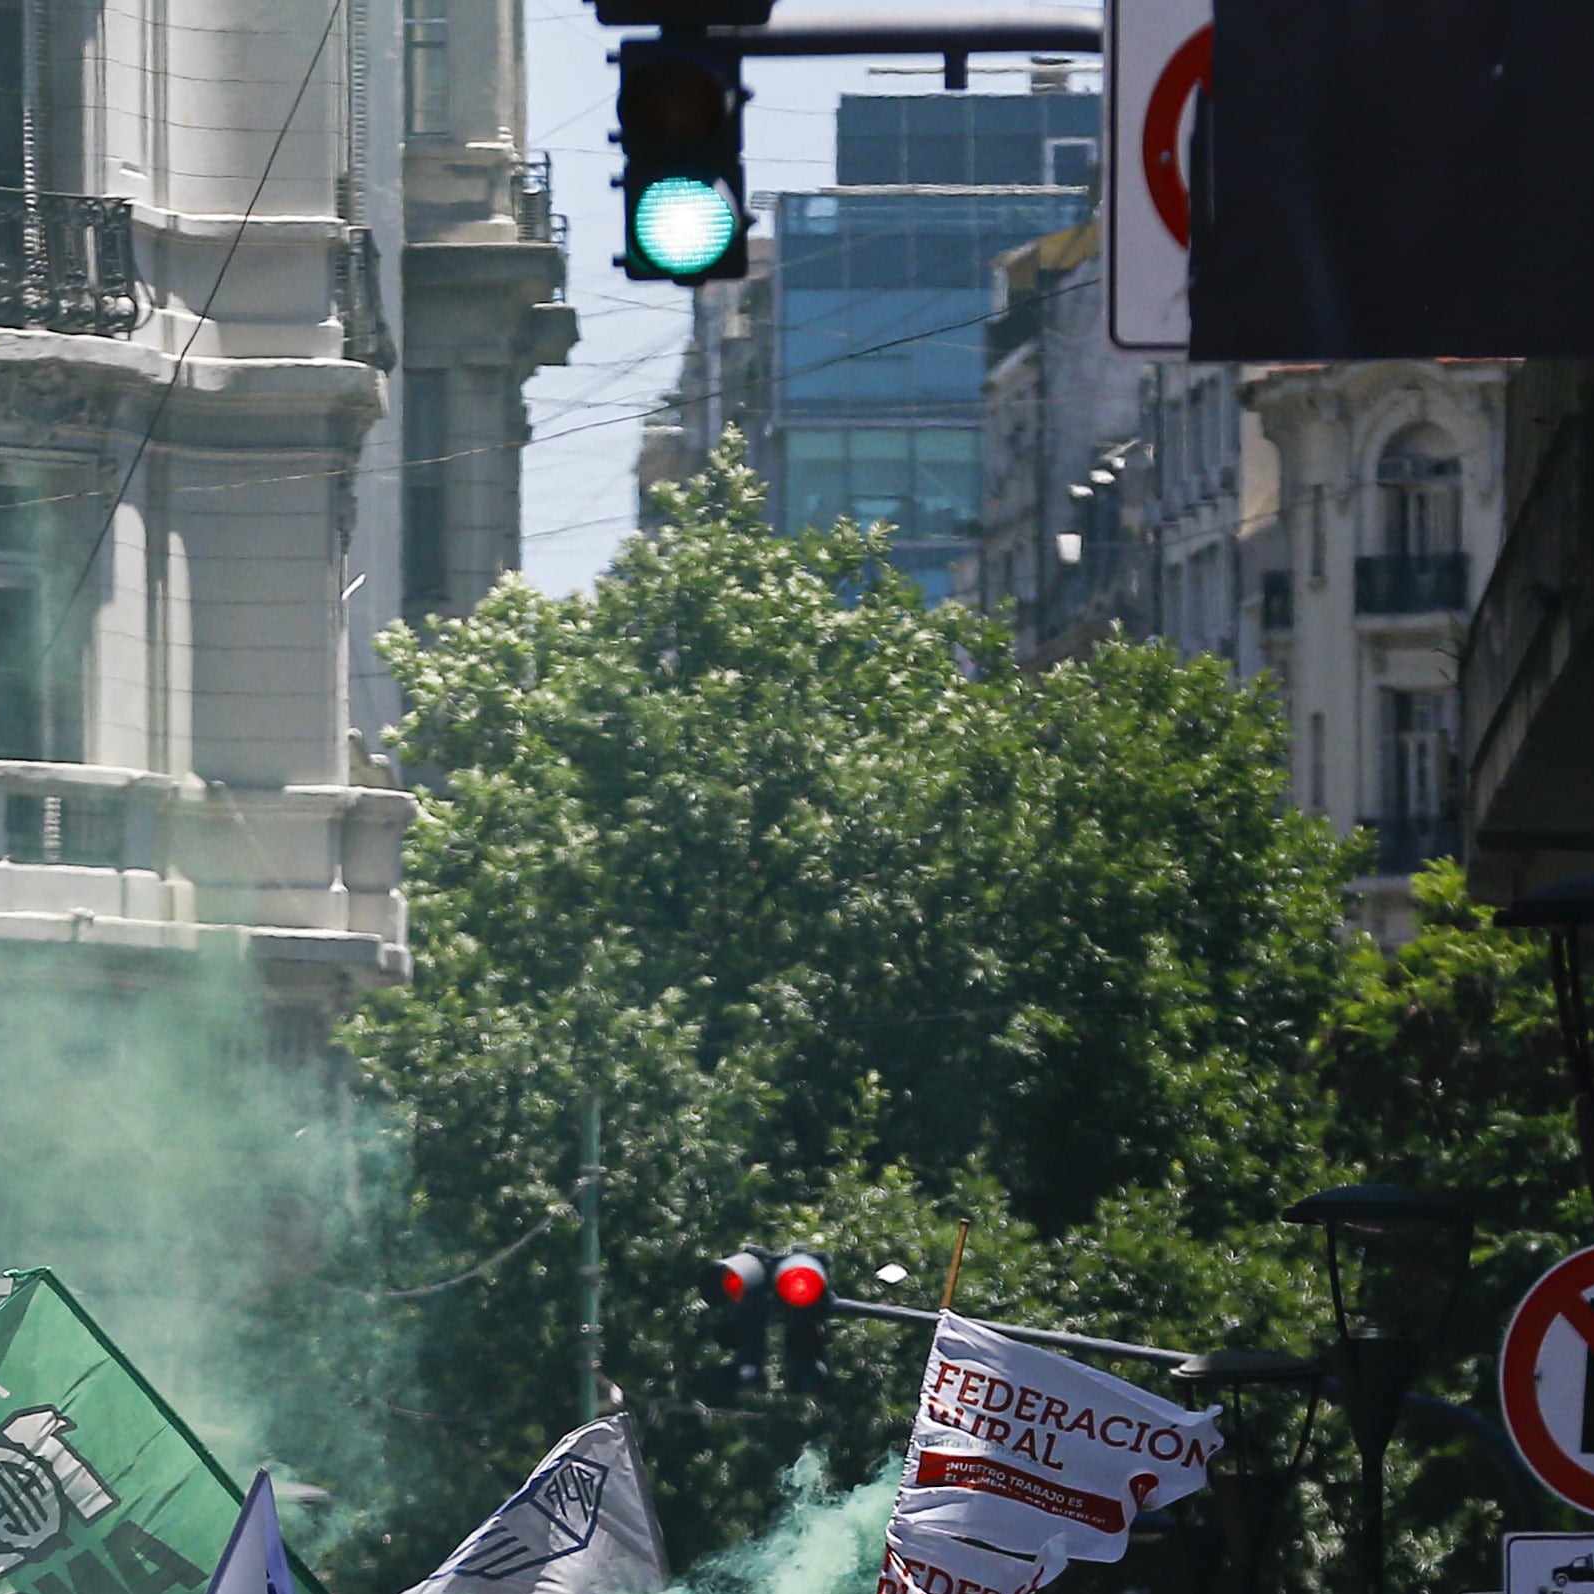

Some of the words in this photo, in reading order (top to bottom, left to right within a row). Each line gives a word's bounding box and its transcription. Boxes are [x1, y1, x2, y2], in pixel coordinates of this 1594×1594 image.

[933, 1360, 1217, 1470] FEDERACIÓN
[1009, 1476, 1065, 1503] TRABAJO
[1067, 1496, 1084, 1510] ES
